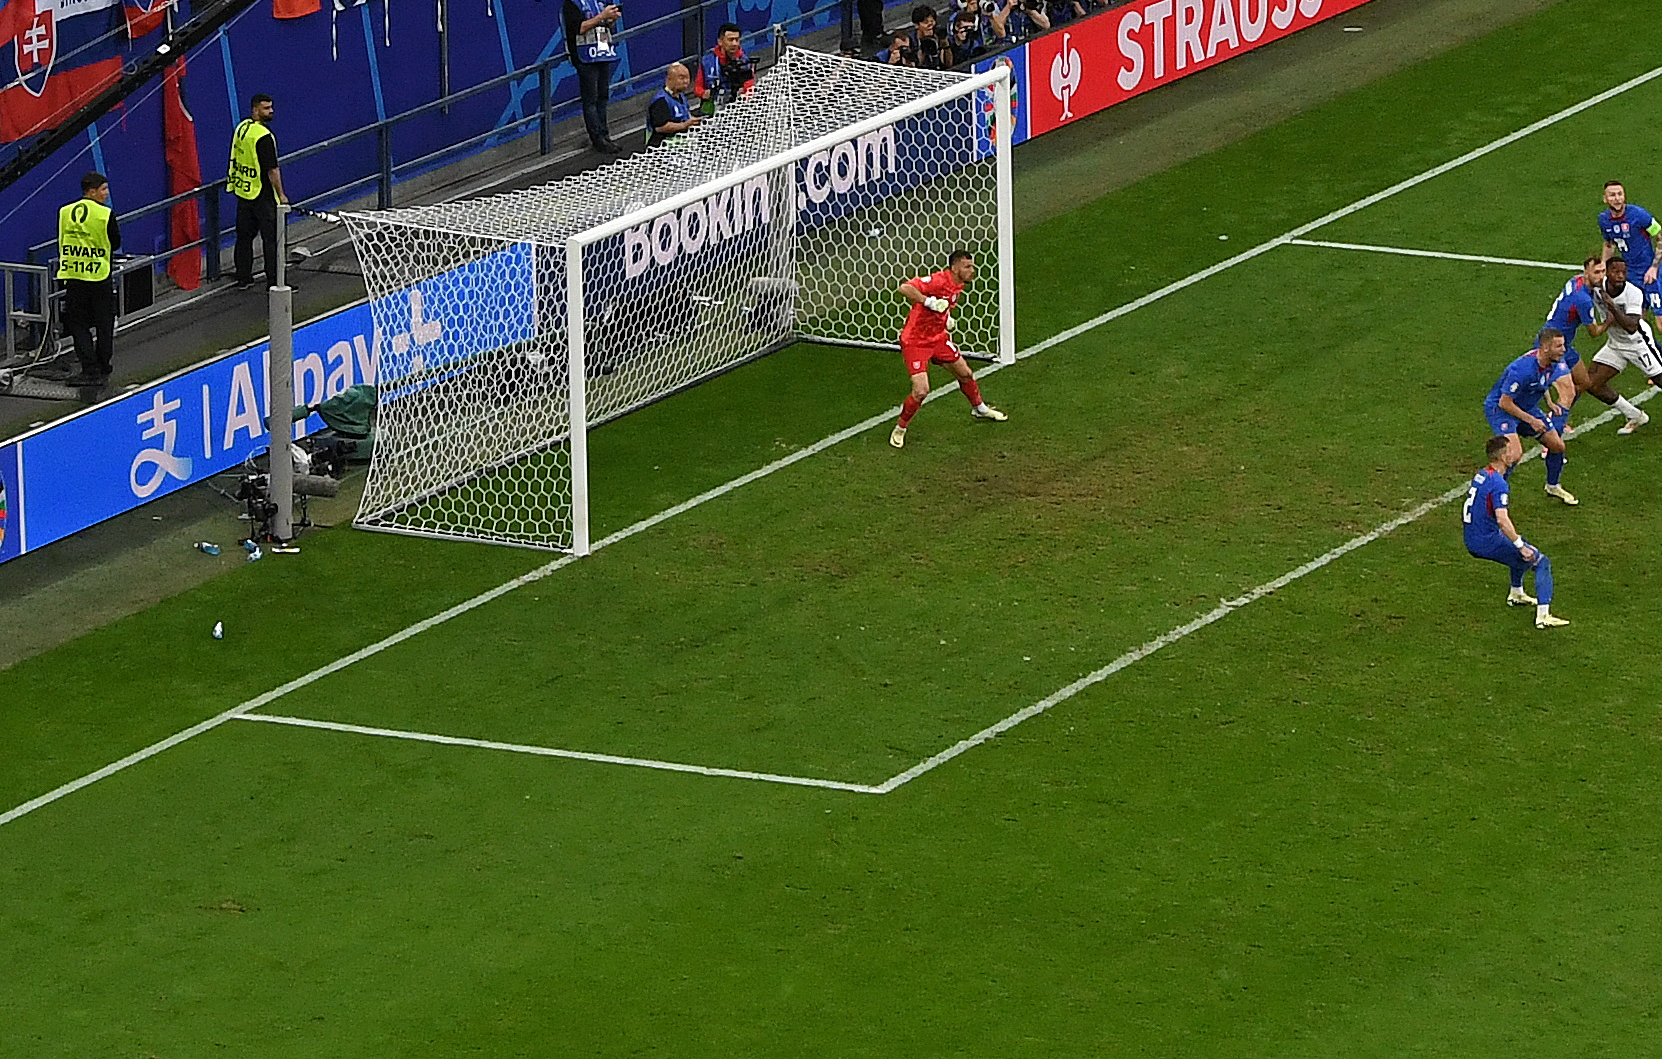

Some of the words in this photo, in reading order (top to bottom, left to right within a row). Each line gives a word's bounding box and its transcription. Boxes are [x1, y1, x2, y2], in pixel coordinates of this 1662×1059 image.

[624, 125, 896, 279] Bookin.com
[1638, 353, 1652, 367] 17
[1463, 486, 1478, 523] 2
